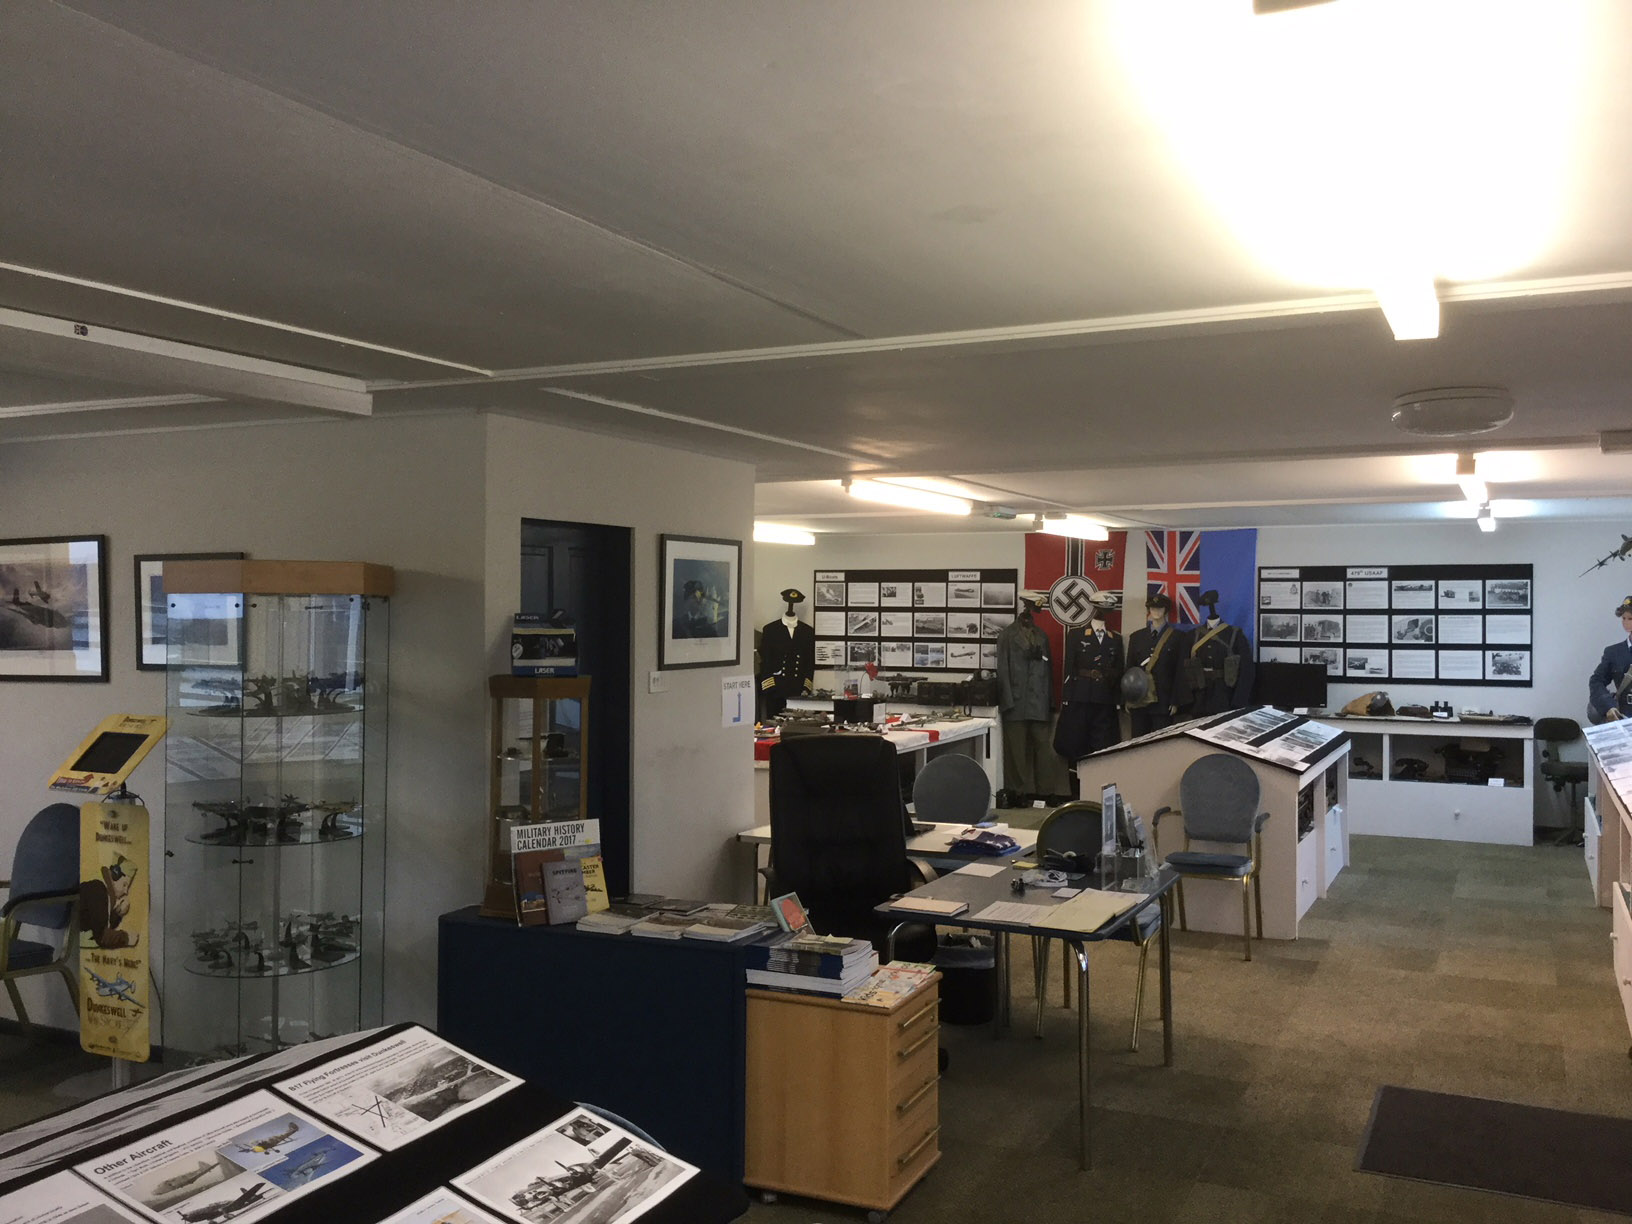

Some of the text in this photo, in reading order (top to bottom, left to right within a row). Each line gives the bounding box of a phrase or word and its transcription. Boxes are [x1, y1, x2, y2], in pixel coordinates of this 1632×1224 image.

[723, 680, 751, 690] START HERE
[516, 823, 585, 839] MILITARY HISTORY
[517, 835, 576, 851] CALENDAR 2017
[288, 1082, 303, 1092] B17
[302, 1074, 326, 1086] Flying
[324, 1060, 359, 1077] Fortresses
[359, 1054, 372, 1063] visit
[371, 1040, 407, 1057] Dunkeswell
[93, 1158, 129, 1175] Other
[129, 1139, 173, 1161] Aircraft
